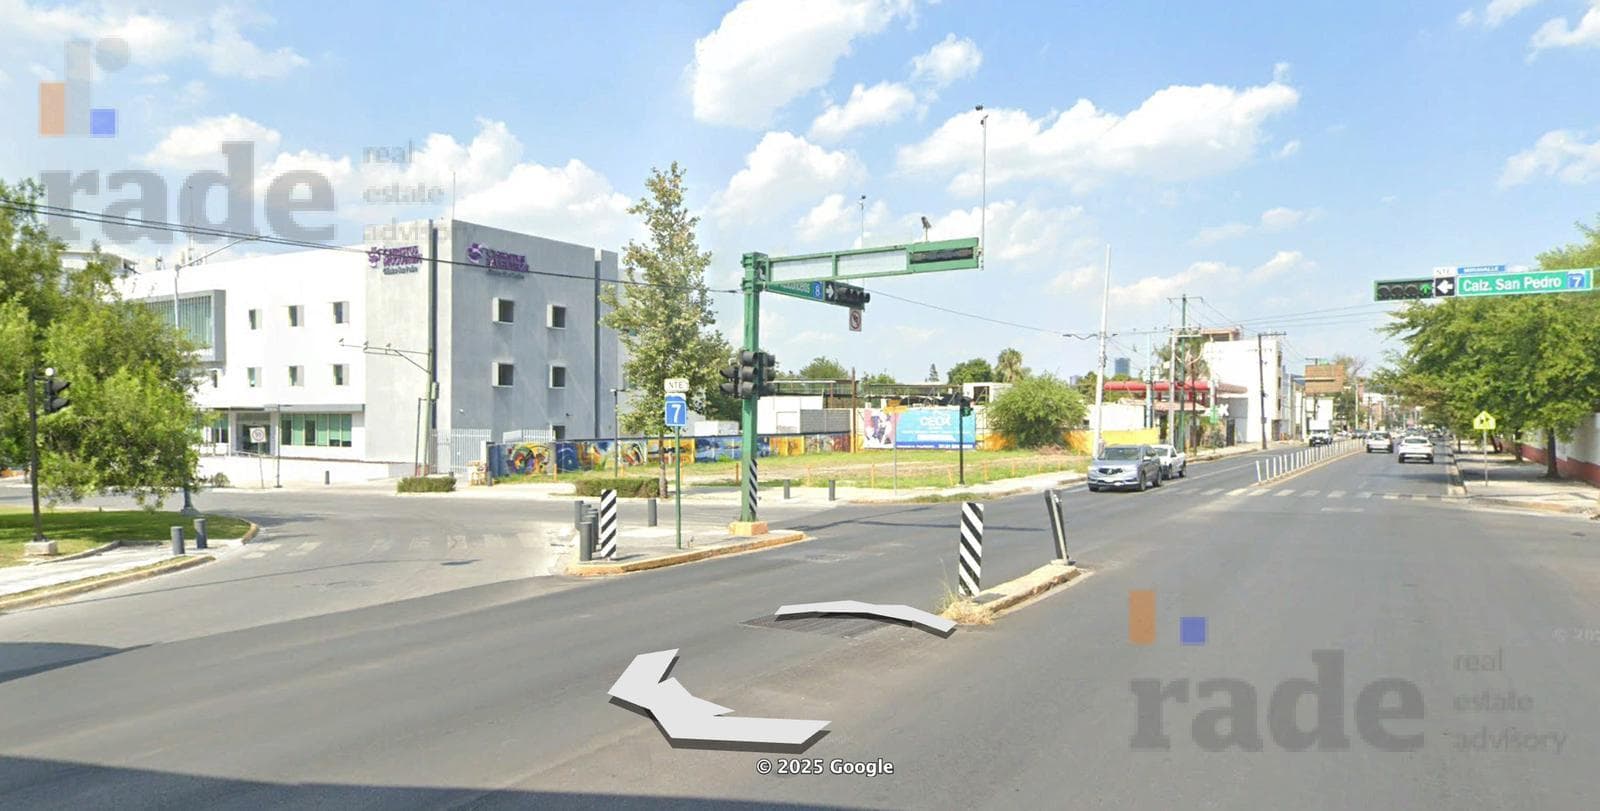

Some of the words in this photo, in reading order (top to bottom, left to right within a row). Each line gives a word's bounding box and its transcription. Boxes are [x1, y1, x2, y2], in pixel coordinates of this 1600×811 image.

[1463, 279, 1493, 292] Calz.
[1495, 278, 1521, 290] San
[1524, 276, 1562, 289] Pedro
[1572, 277, 1582, 288] 7
[669, 381, 686, 389] NTE
[671, 403, 682, 423] 7
